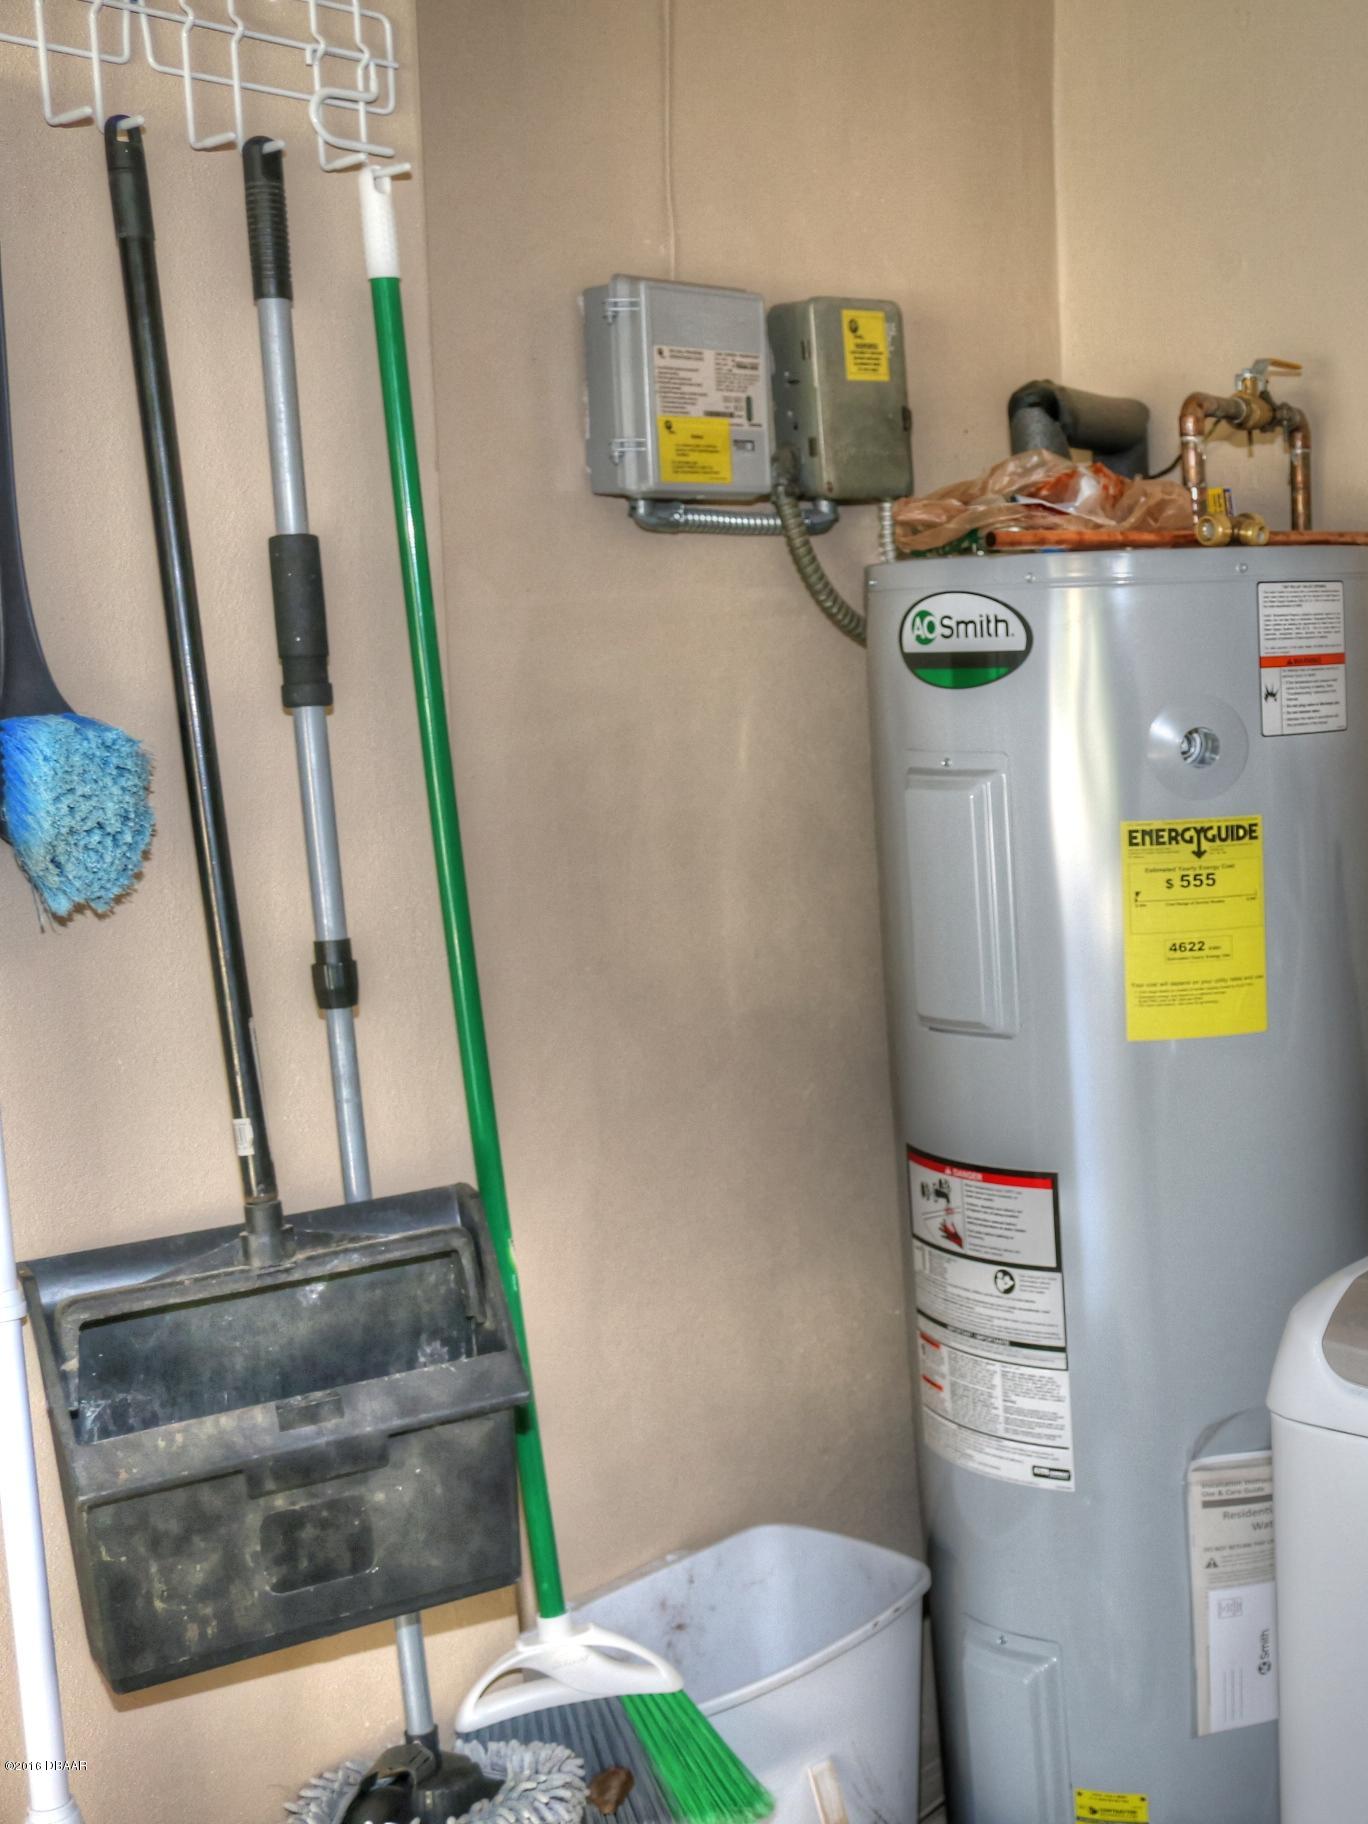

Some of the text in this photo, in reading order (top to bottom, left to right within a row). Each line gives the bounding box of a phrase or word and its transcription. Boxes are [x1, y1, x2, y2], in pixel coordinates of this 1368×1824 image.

[940, 614, 1009, 640] Smith
[1128, 823, 1259, 852] ENERGYGUIDE
[1180, 873, 1216, 888] 555
[1169, 941, 1206, 953] 4622
[1259, 1628, 1270, 1660] Smith
